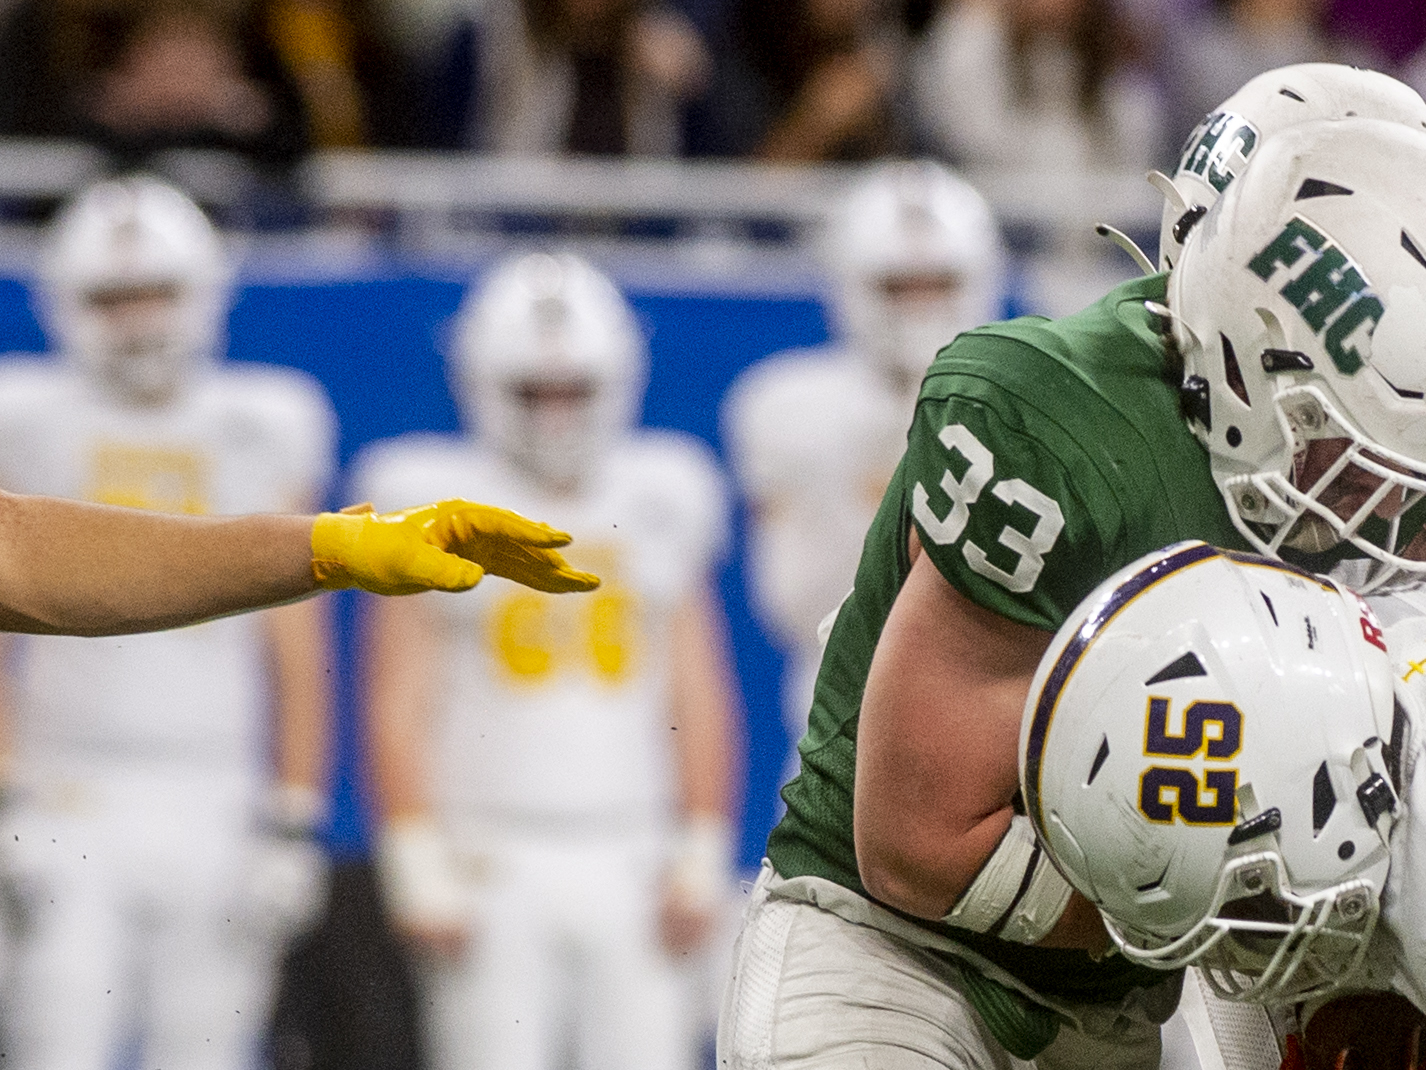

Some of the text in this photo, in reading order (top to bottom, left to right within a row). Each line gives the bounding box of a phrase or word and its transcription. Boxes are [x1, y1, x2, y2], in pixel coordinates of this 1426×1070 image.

[1173, 112, 1257, 194] HC
[1247, 215, 1386, 376] FHC
[911, 423, 1066, 594] 33
[1138, 695, 1244, 828] 25
